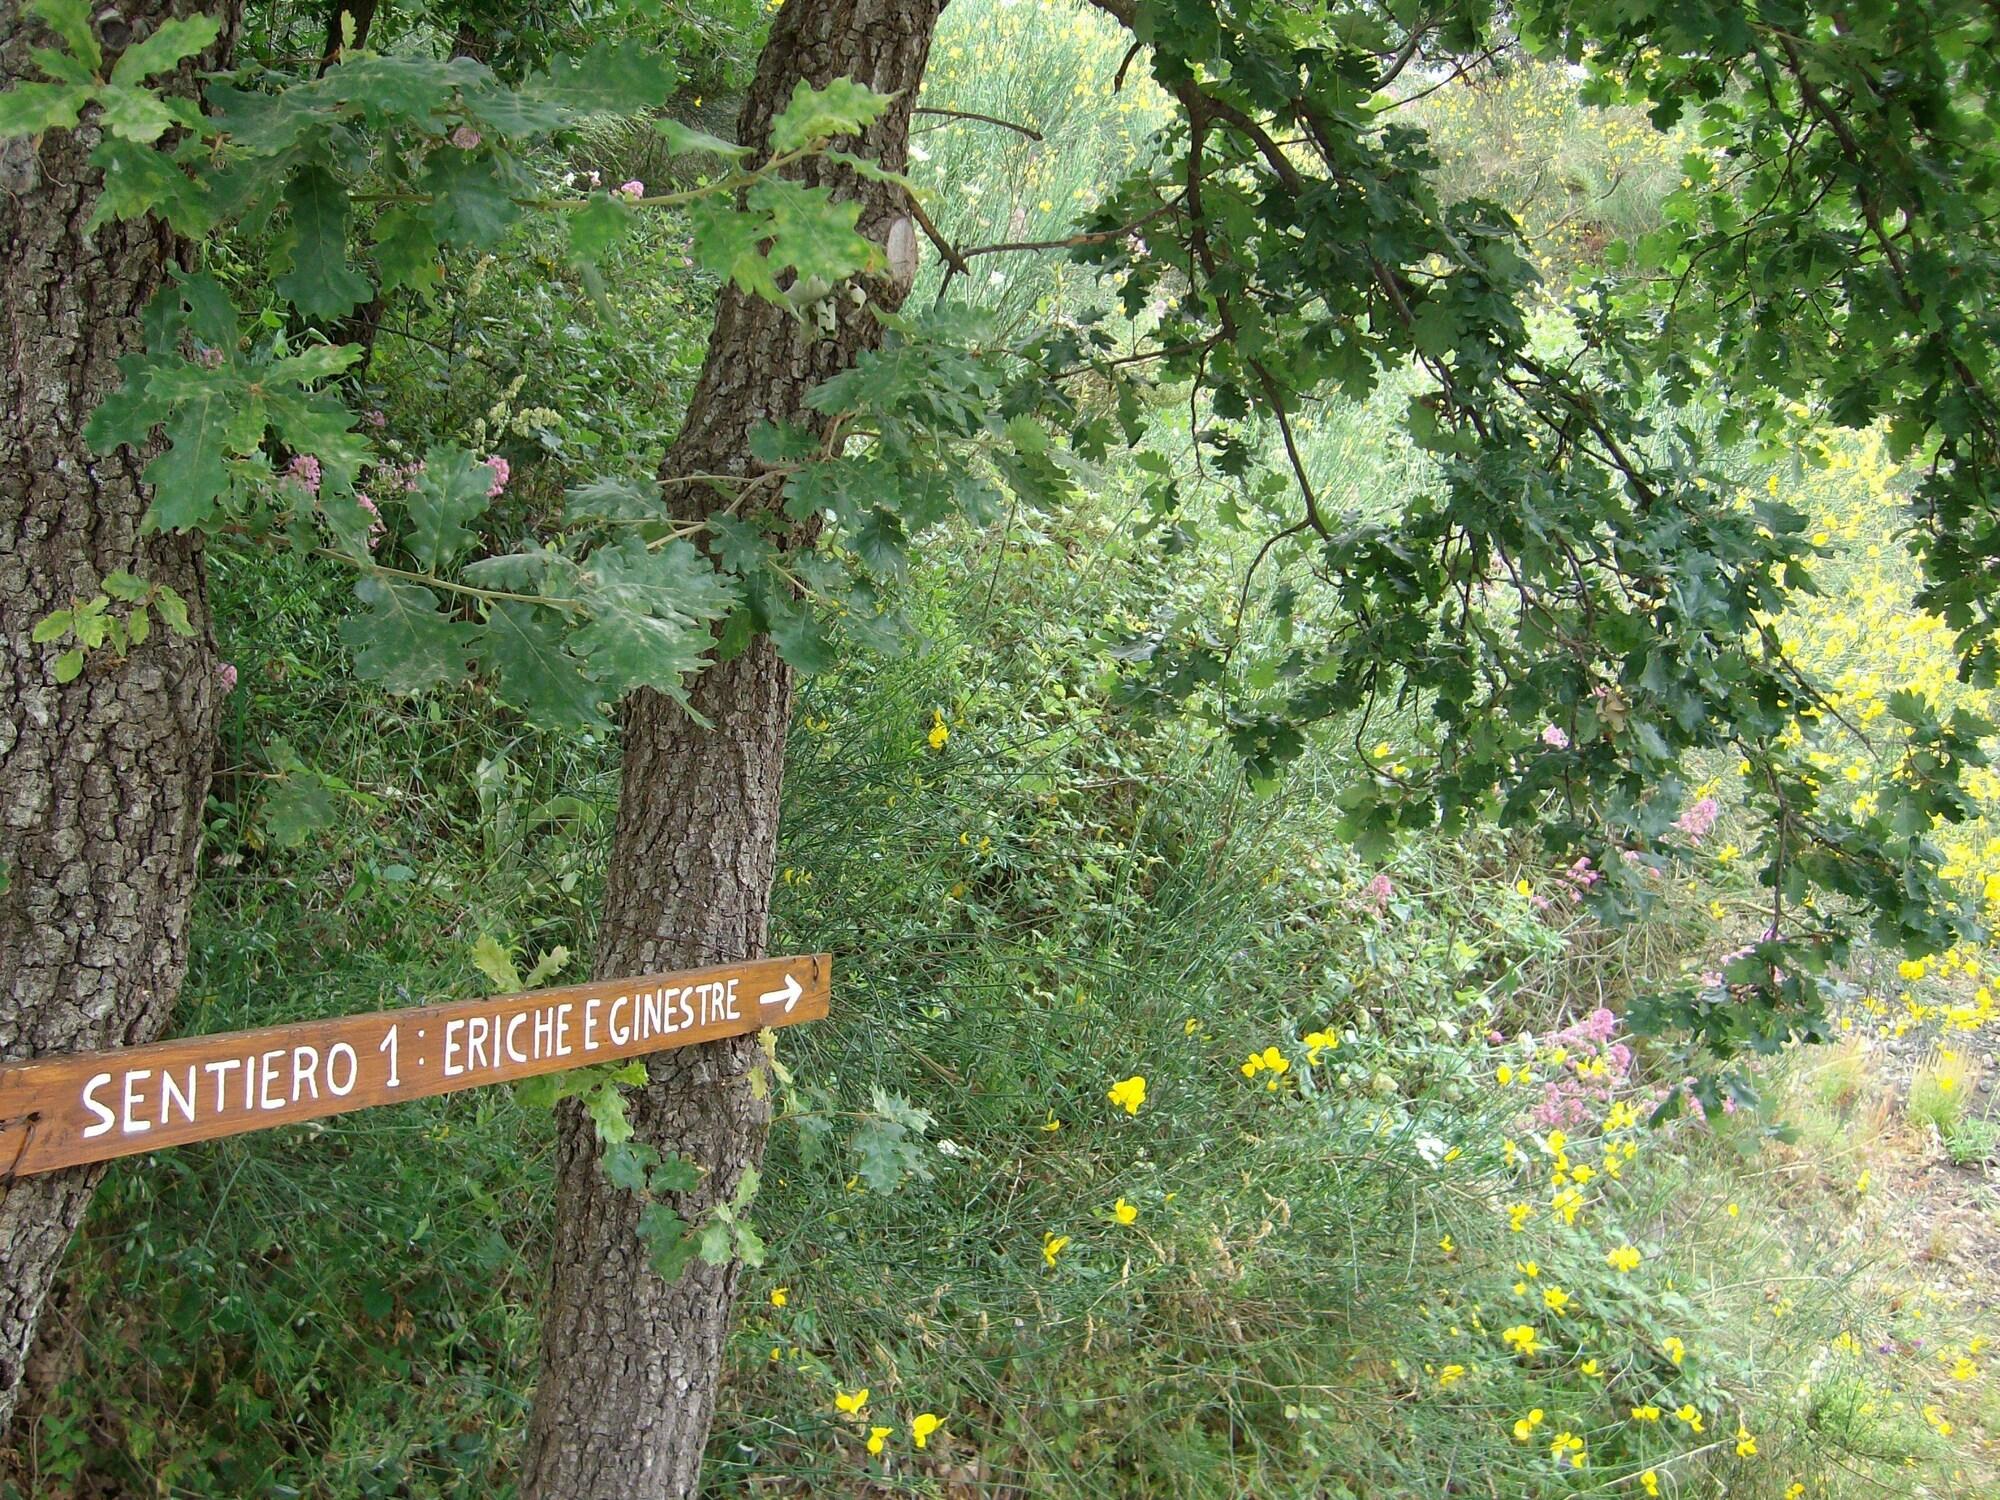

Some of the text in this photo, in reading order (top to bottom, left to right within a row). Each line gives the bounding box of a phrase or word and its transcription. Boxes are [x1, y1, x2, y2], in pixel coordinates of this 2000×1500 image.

[82, 1042, 358, 1139] SENTIERO
[444, 1003, 573, 1076] ERICHE
[584, 998, 602, 1051] E
[609, 978, 742, 1046] GINESTRE
